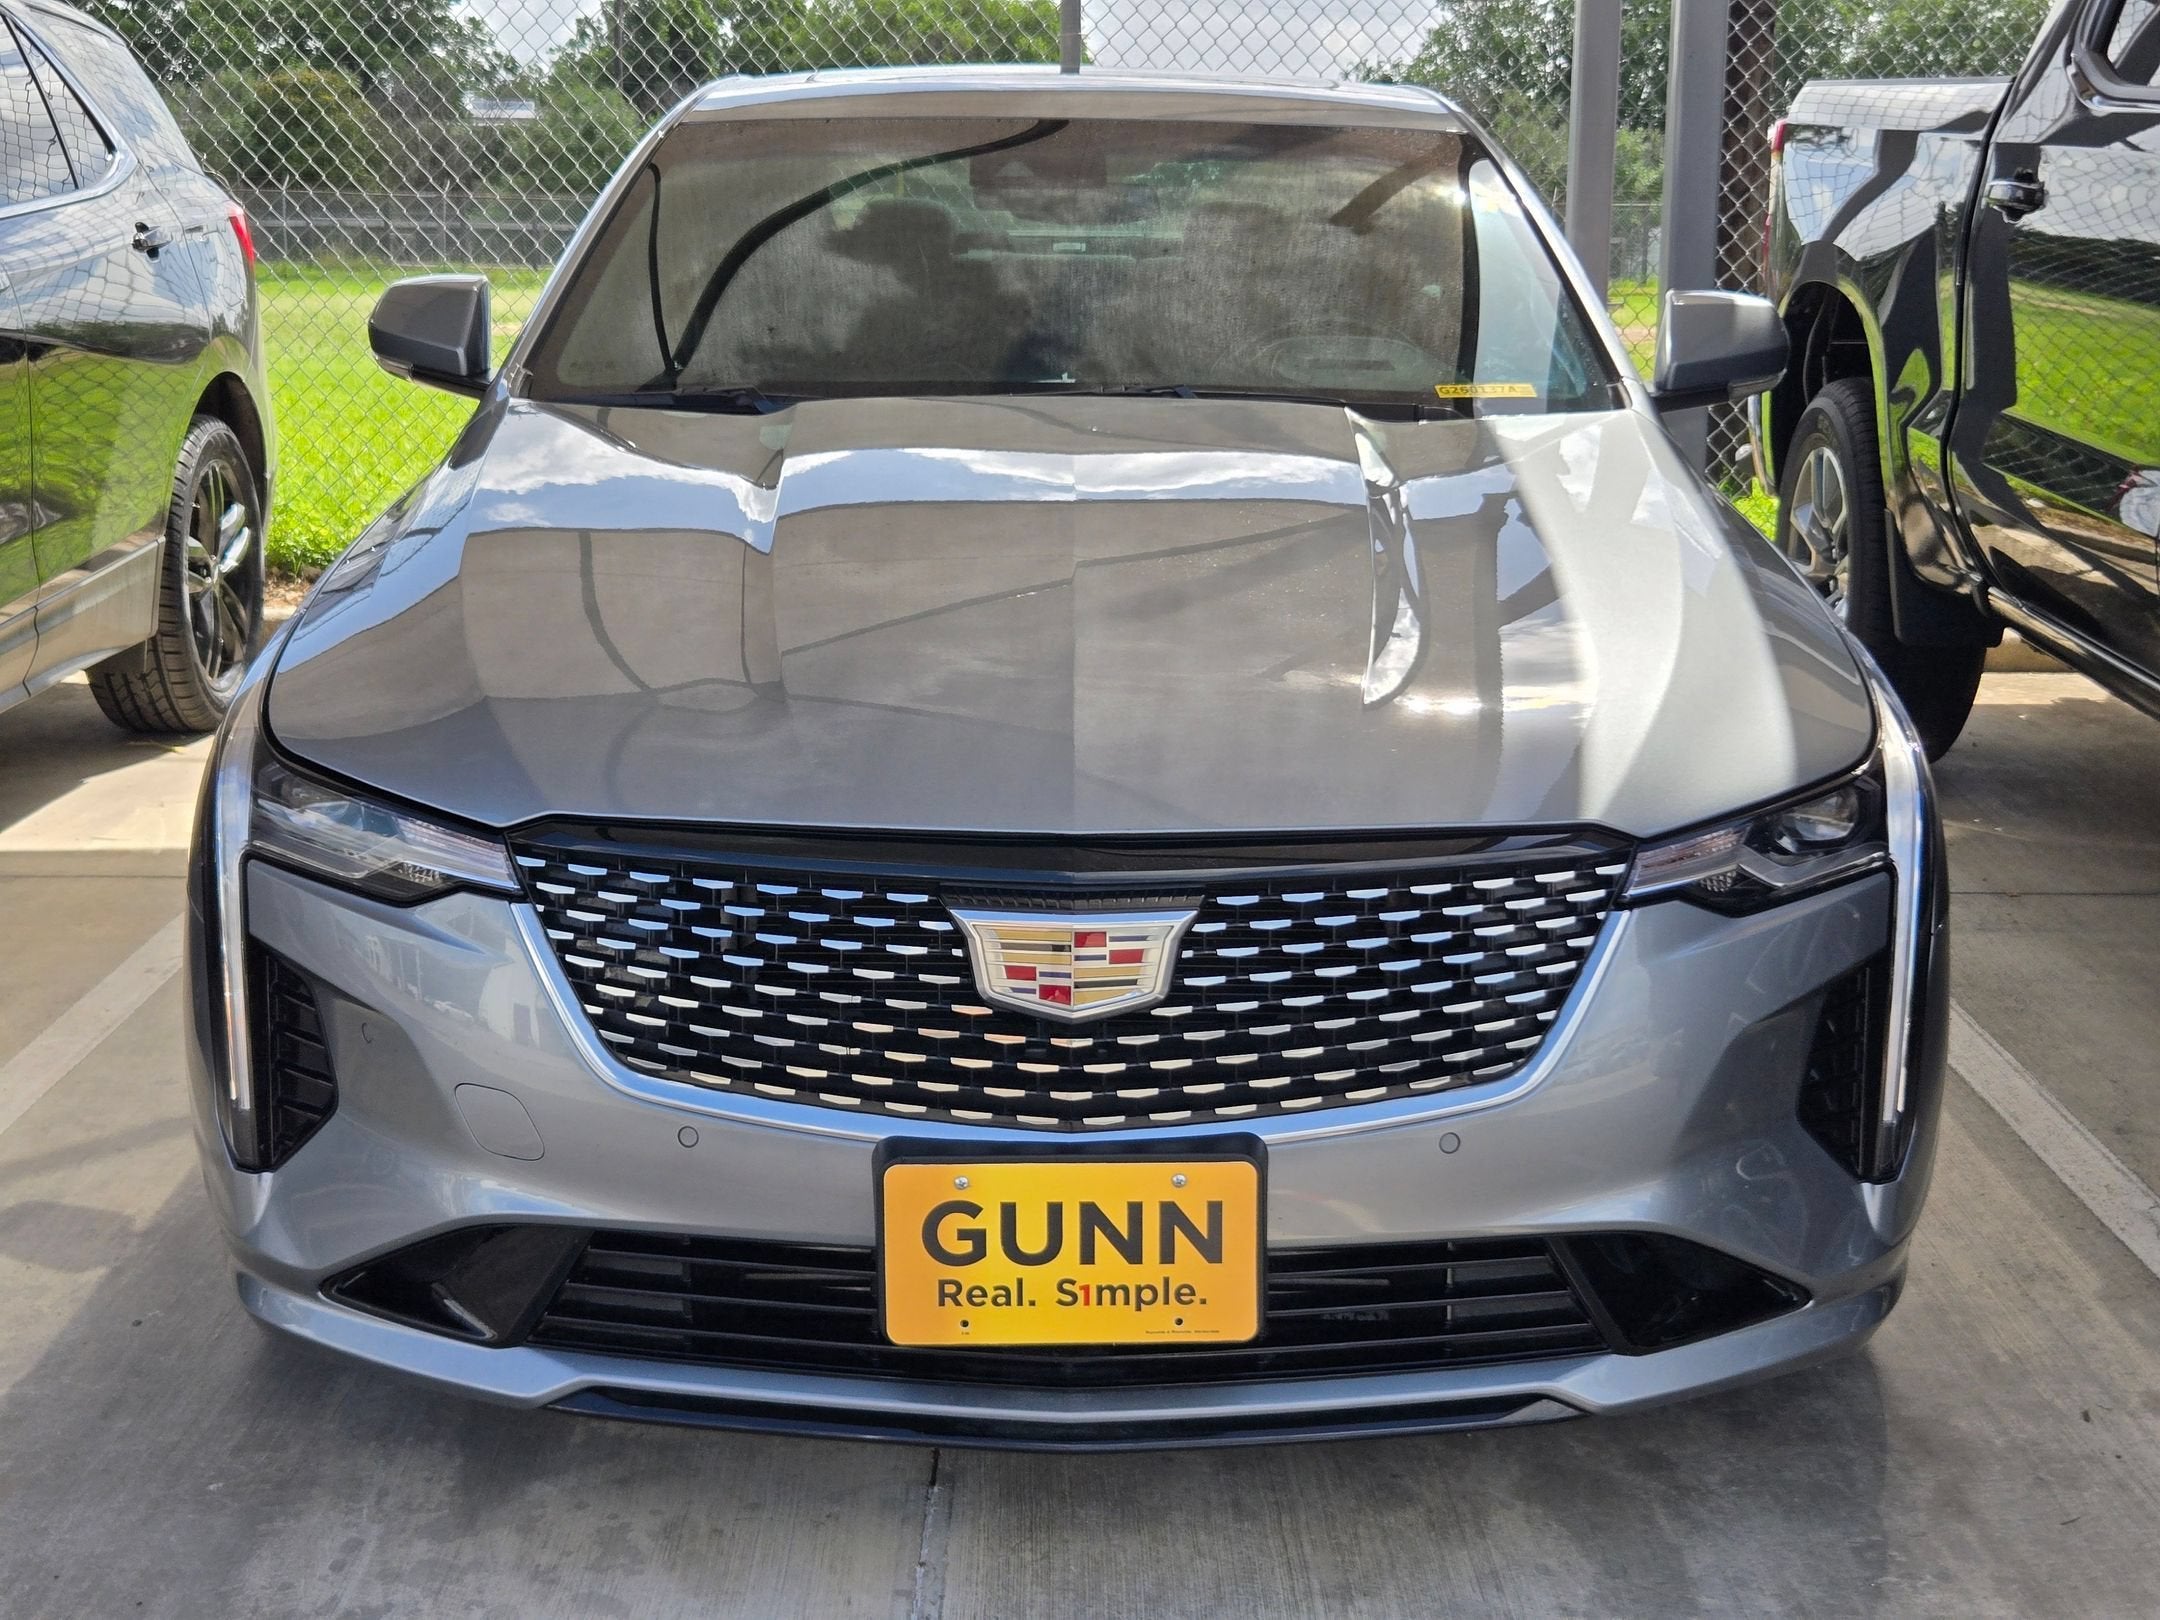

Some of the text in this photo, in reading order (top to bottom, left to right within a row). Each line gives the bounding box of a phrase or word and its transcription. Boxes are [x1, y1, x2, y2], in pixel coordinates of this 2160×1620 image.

[921, 1199, 1223, 1267] GUNN
[937, 1276, 1208, 1312] Real. S1mple.
